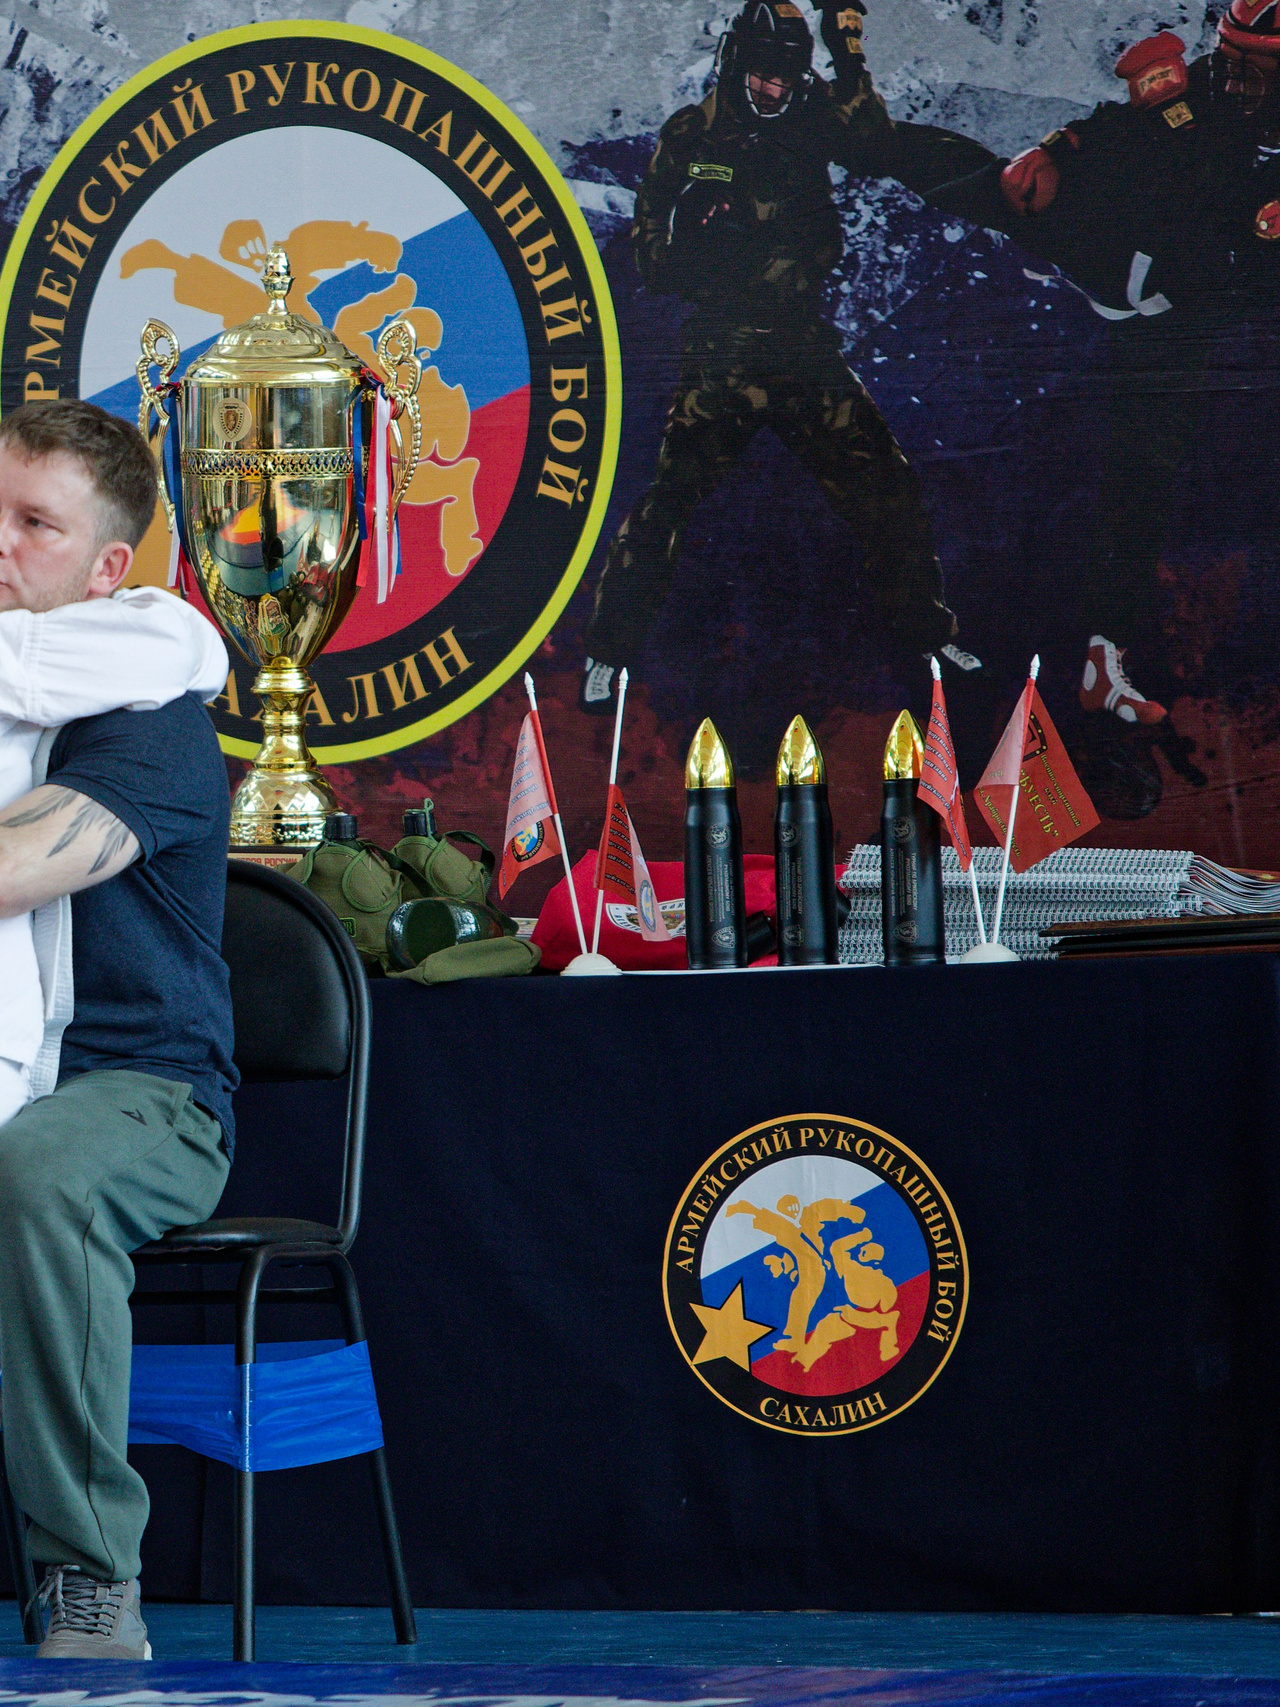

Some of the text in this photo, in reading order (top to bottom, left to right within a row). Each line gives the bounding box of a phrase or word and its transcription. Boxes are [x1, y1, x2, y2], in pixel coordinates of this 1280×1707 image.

[24, 60, 593, 510] РМЕЙСКИЙ РУКОПАШНЫЙ БОЙ
[207, 626, 475, 726] ААЛИН
[676, 1127, 960, 1343] АРМЕЙСКИЙ РУКОПАШНЫЙ БОЙ
[760, 1391, 887, 1427] САХАЛИН
